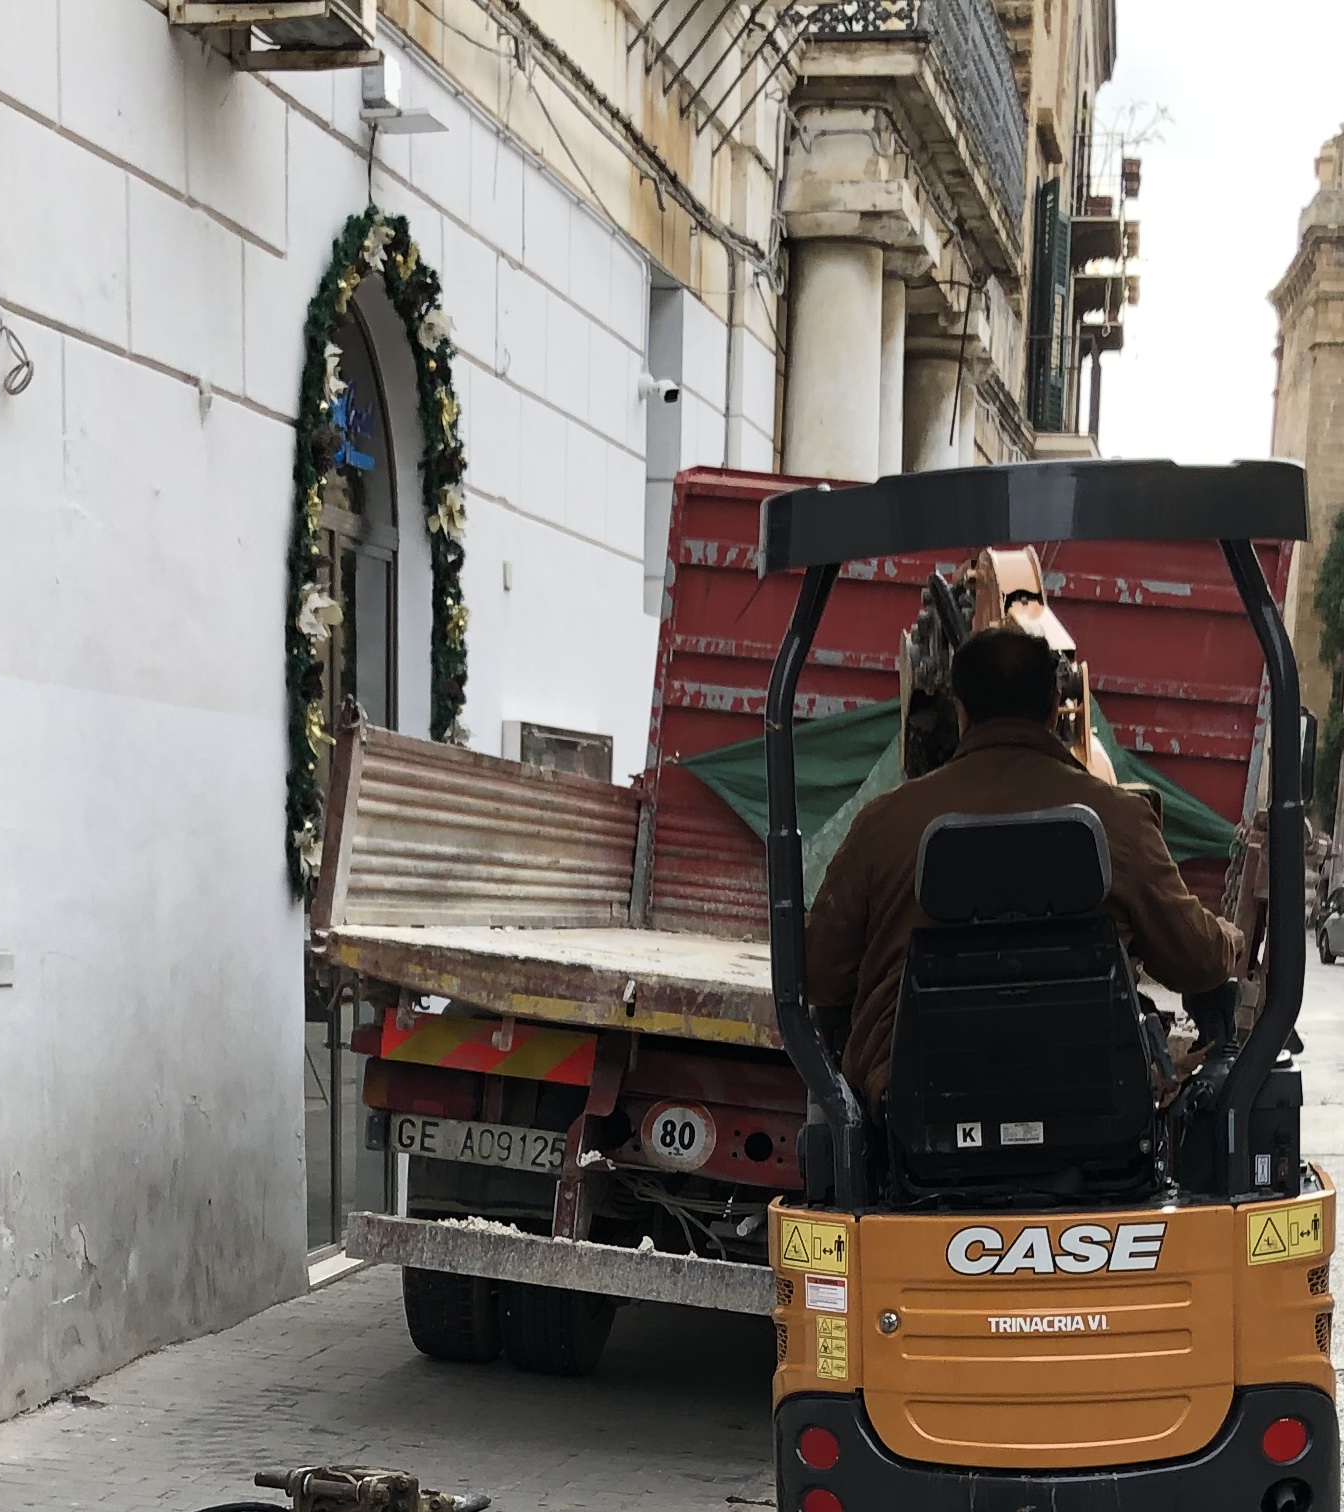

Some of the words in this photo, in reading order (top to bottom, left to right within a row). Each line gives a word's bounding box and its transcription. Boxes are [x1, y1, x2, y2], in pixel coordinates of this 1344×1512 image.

[398, 1119, 439, 1152] GE
[660, 1119, 695, 1150] 80
[962, 1127, 976, 1143] K
[946, 1221, 1167, 1276] CASE
[988, 1315, 1085, 1333] TRINACRIA
